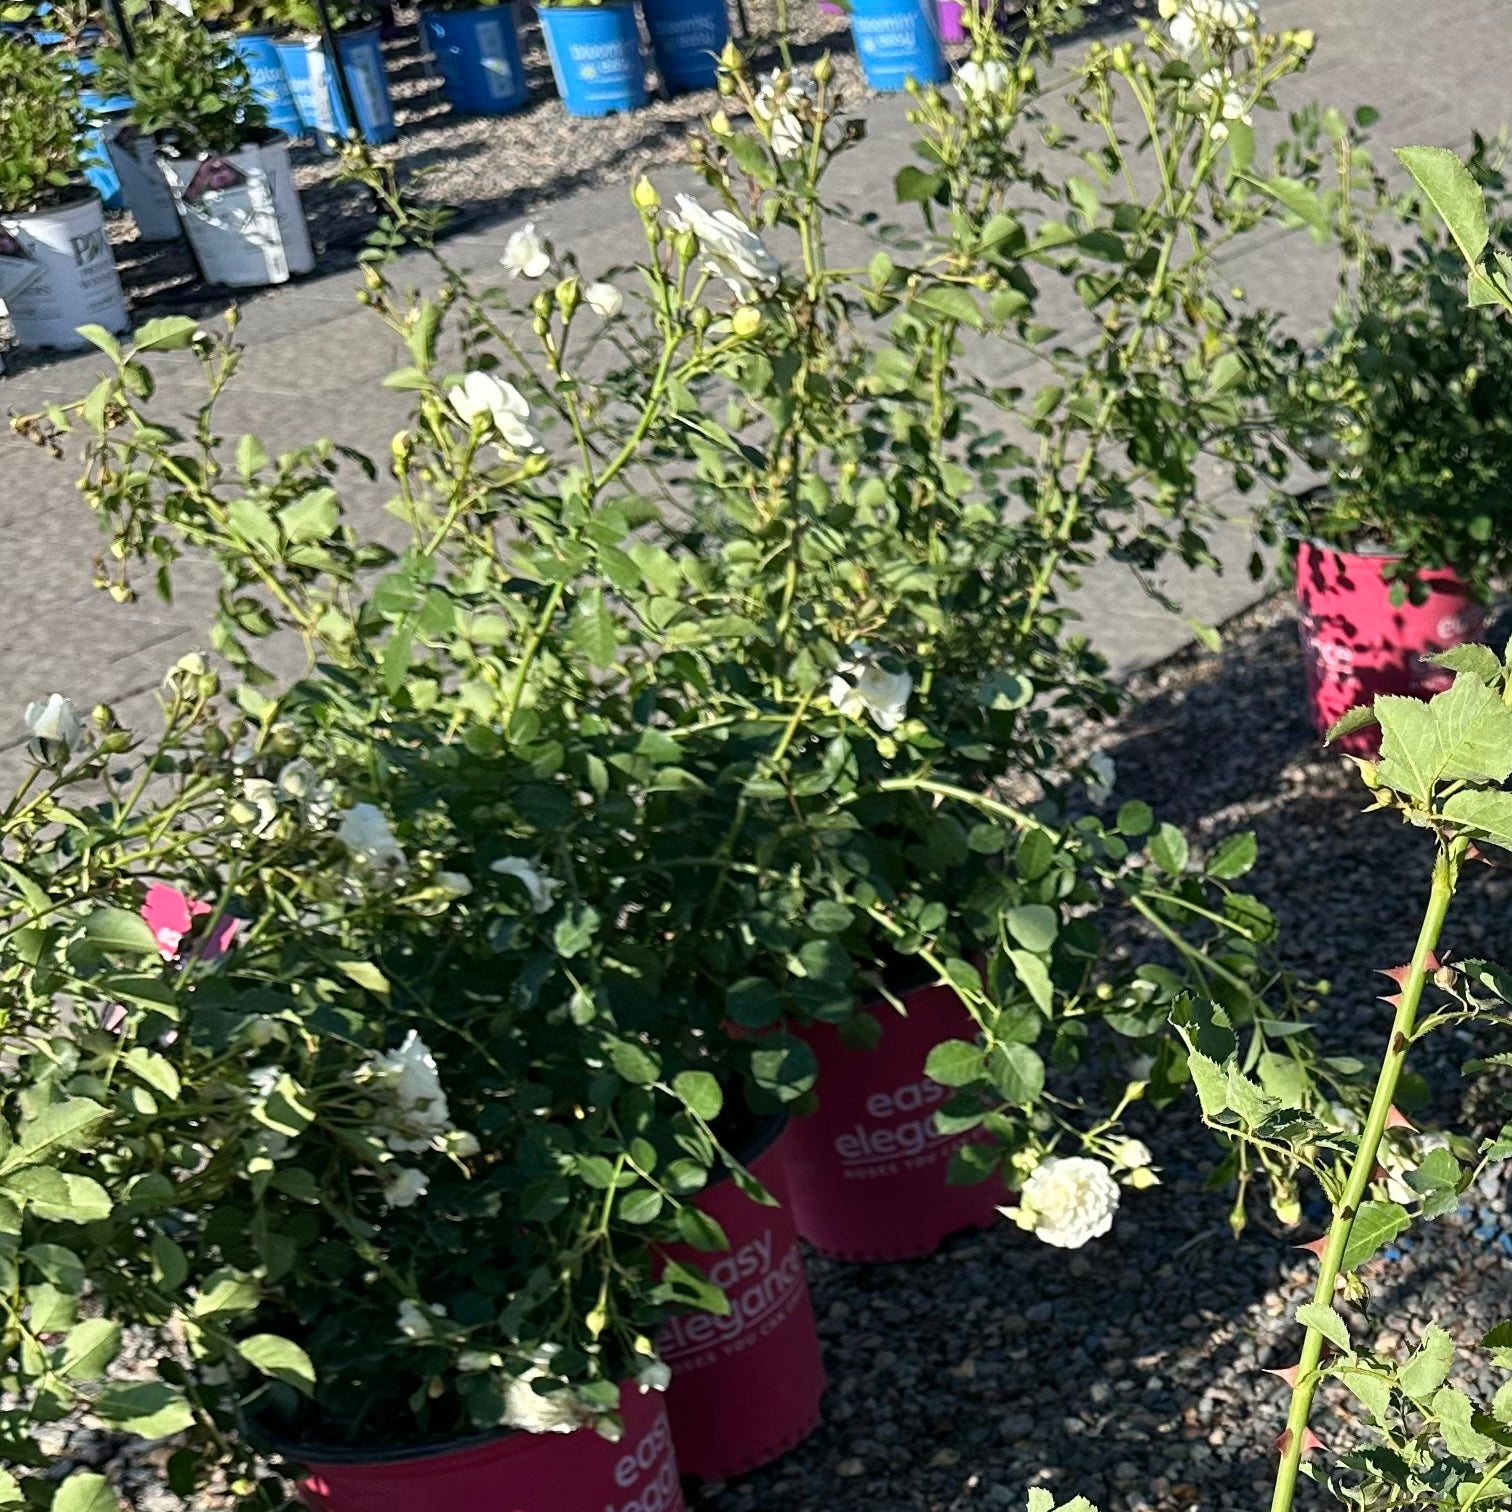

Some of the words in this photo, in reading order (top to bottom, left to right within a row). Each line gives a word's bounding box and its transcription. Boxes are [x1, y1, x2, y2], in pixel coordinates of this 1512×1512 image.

[866, 1078, 955, 1118] eas
[709, 1229, 772, 1289] asy
[615, 1411, 671, 1488] eas
